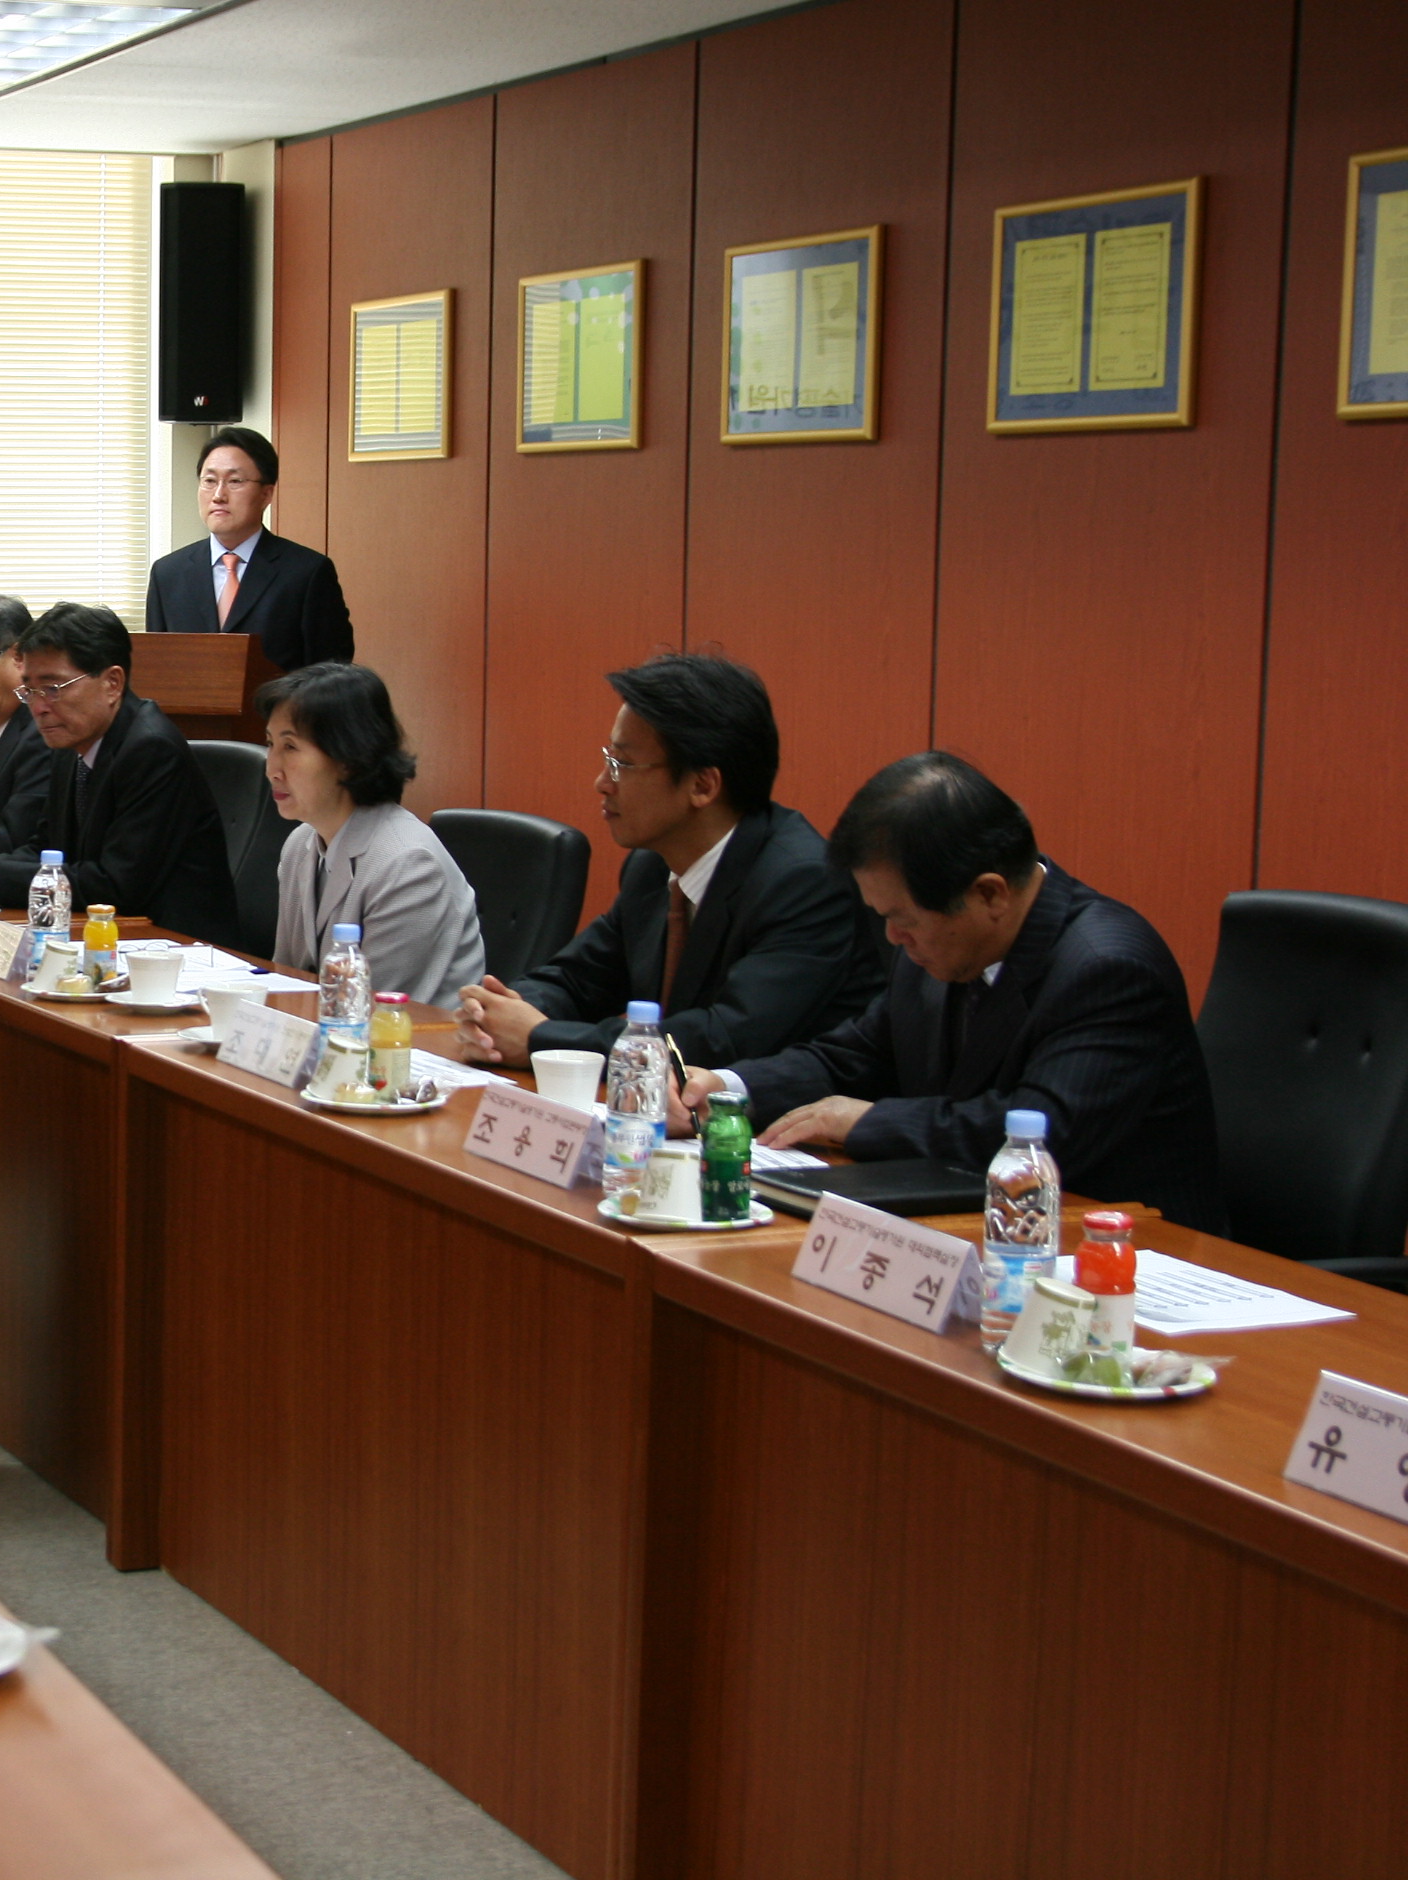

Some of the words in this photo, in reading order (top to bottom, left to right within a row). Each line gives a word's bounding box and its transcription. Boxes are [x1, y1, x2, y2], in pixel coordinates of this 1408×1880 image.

[472, 1112, 499, 1144] 조
[811, 1233, 838, 1274] 이
[859, 1250, 891, 1291] 종
[1307, 1424, 1348, 1475] 유
